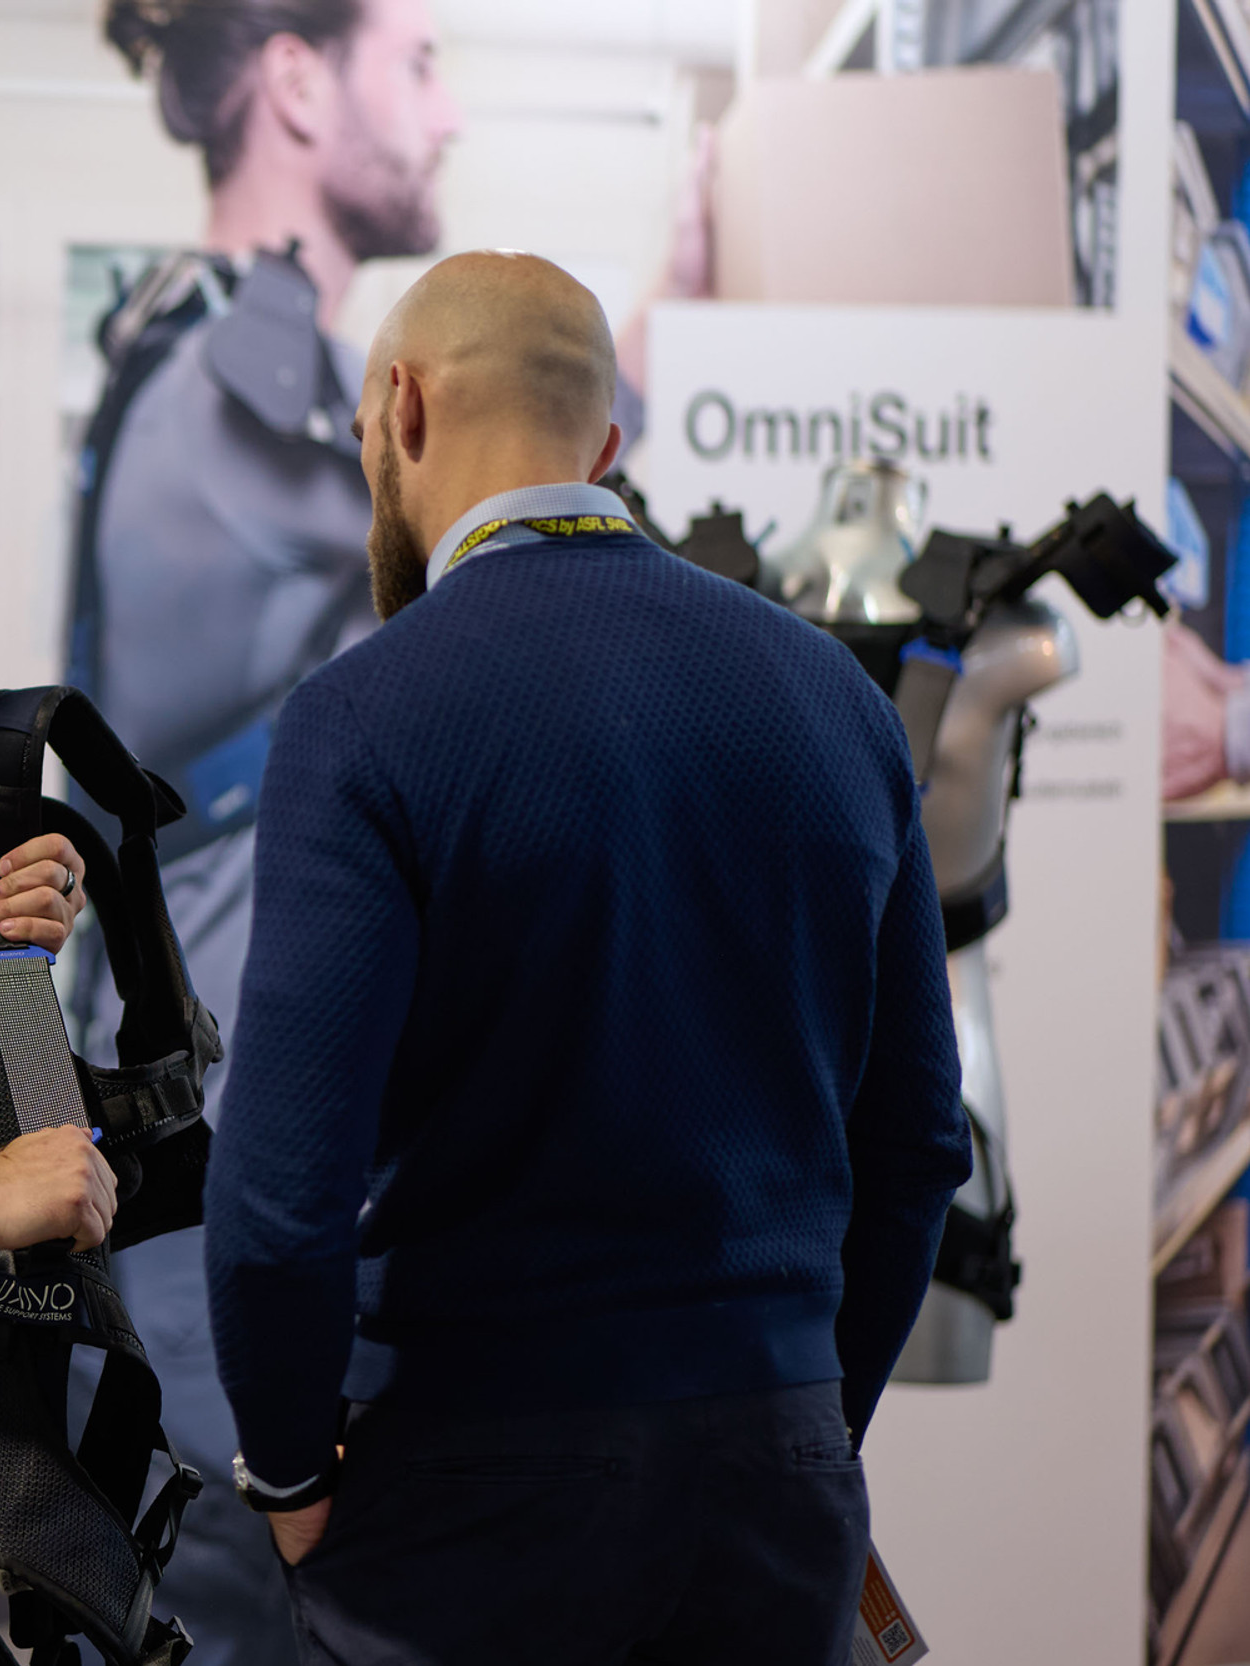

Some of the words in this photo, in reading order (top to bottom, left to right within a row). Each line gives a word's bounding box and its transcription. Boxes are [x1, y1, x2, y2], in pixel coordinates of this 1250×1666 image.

[685, 389, 994, 462] OmniSuit
[558, 518, 576, 536] by
[4, 1304, 39, 1319] SUPPORT
[38, 1312, 73, 1321] SYSTEMS
